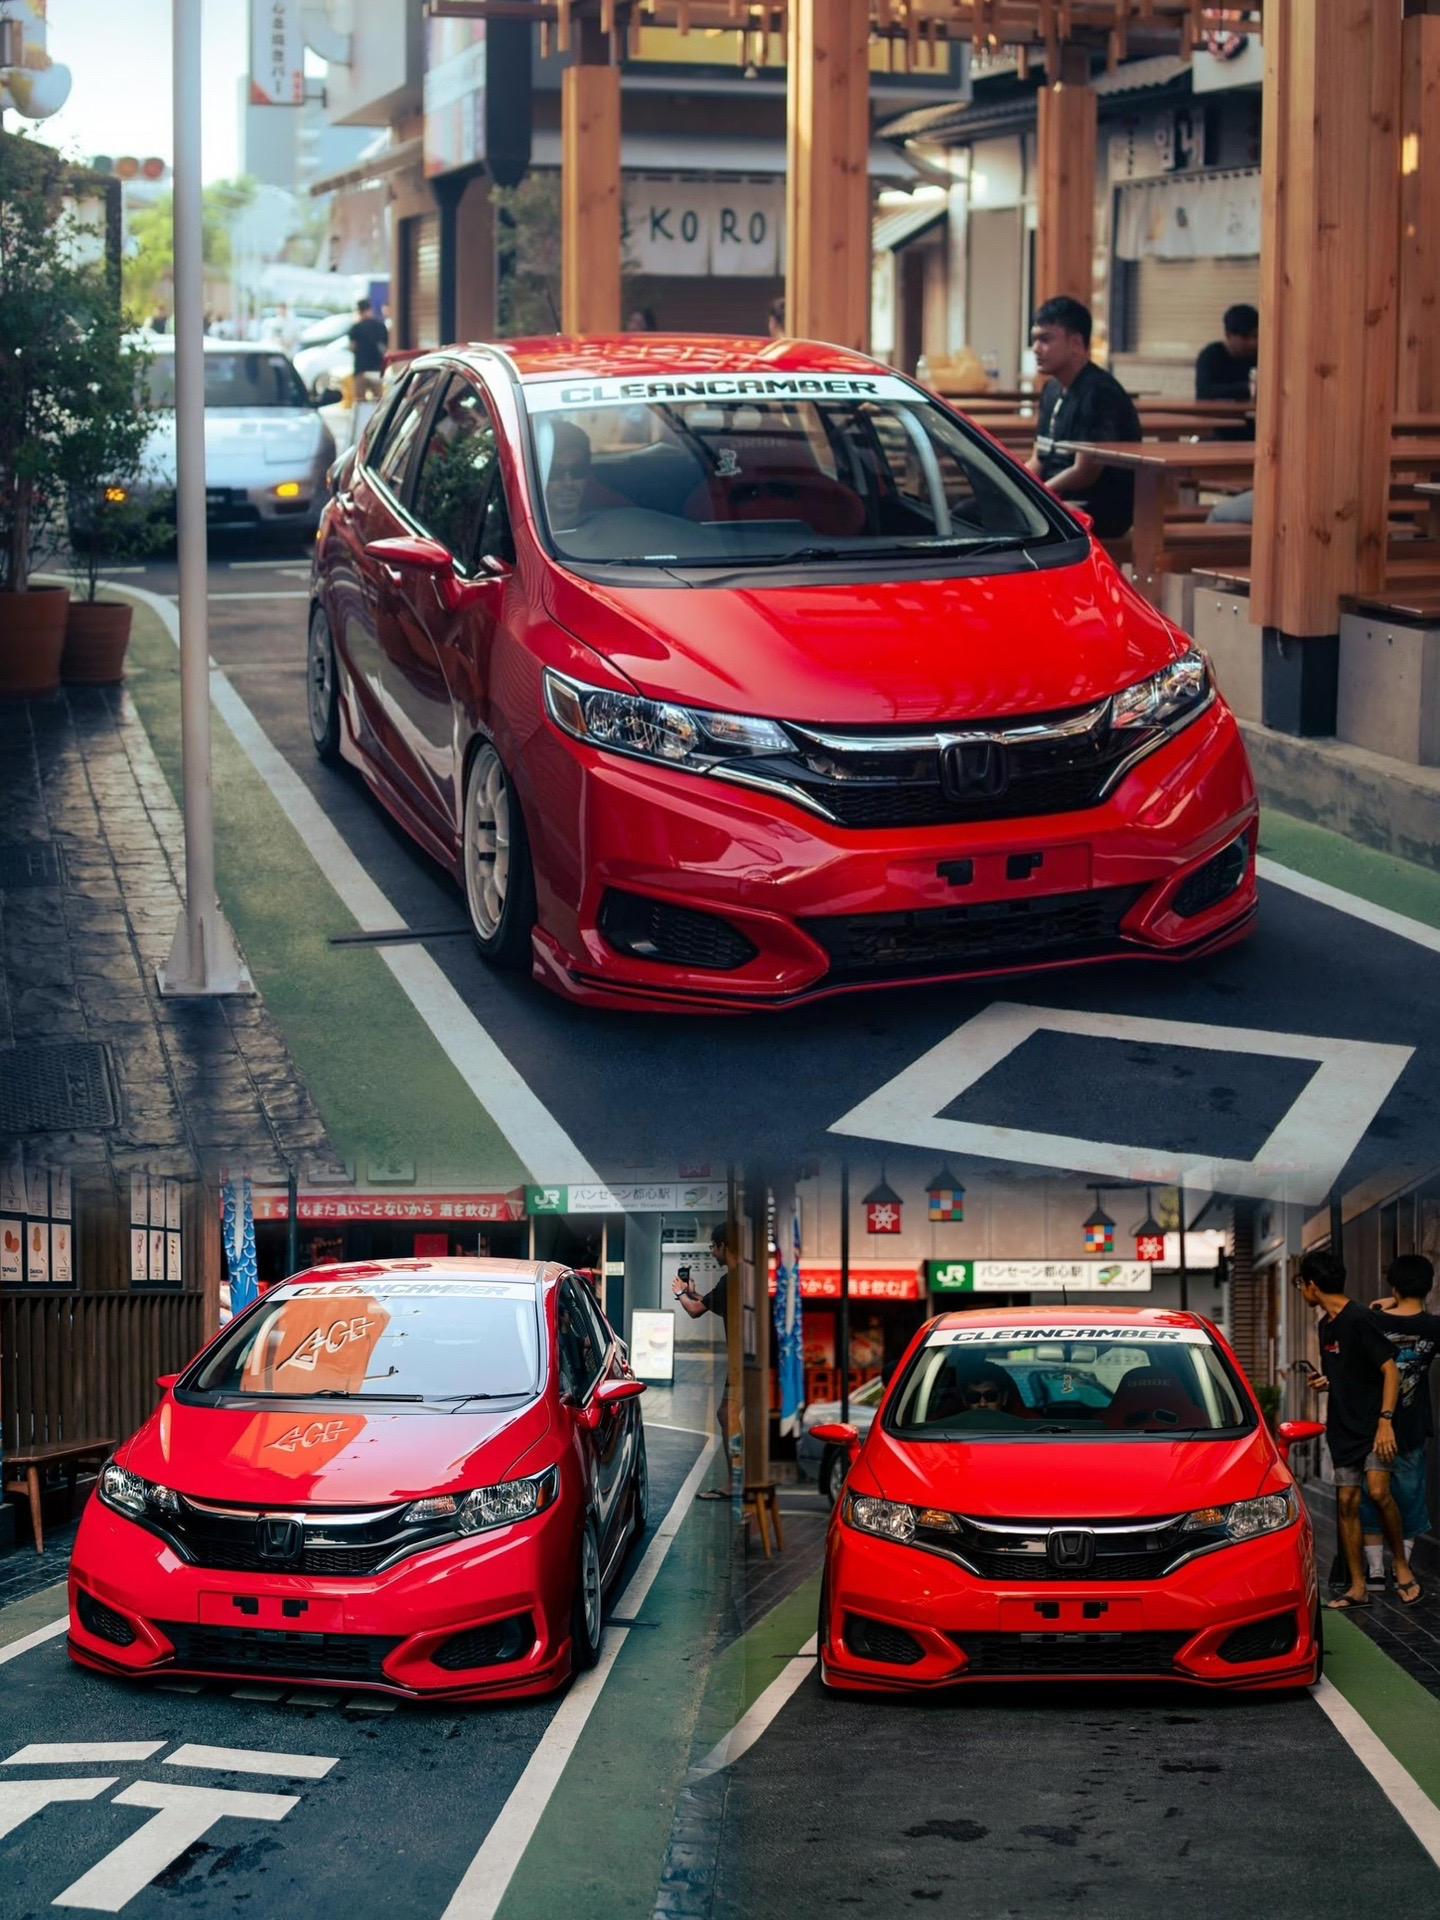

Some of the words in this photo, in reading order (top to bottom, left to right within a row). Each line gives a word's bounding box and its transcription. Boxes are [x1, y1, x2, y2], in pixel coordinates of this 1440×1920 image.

[561, 379, 880, 404] CLEANCAMBER
[534, 1190, 561, 1206] JR
[936, 1264, 966, 1282] JR
[292, 1283, 512, 1297] CLEANCAMBER
[953, 1328, 1181, 1342] CLEANCAMBER
